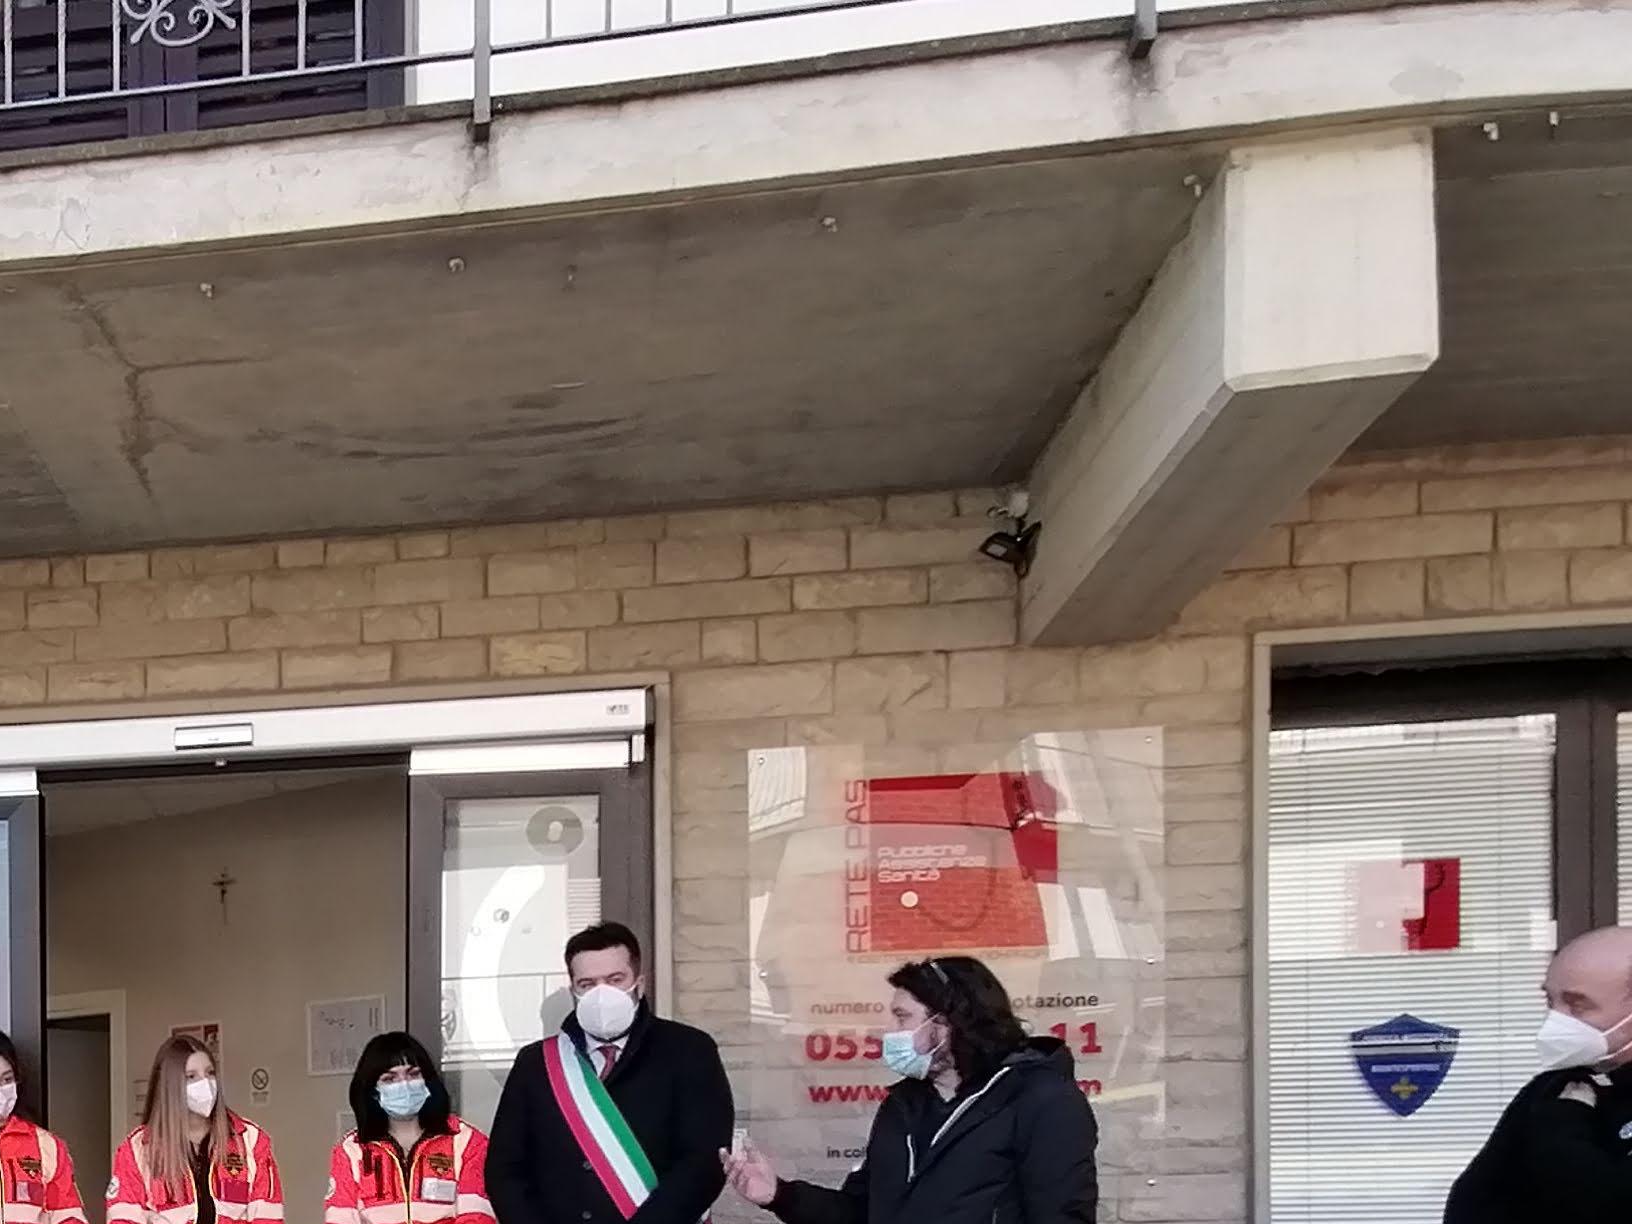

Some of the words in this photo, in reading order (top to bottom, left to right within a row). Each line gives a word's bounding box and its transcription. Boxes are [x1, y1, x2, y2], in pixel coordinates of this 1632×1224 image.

[846, 779, 867, 849] PAS
[846, 859, 867, 953] RETE
[811, 1000, 884, 1014] numero
[1012, 992, 1100, 1008] otazione
[827, 1145, 841, 1158] in
